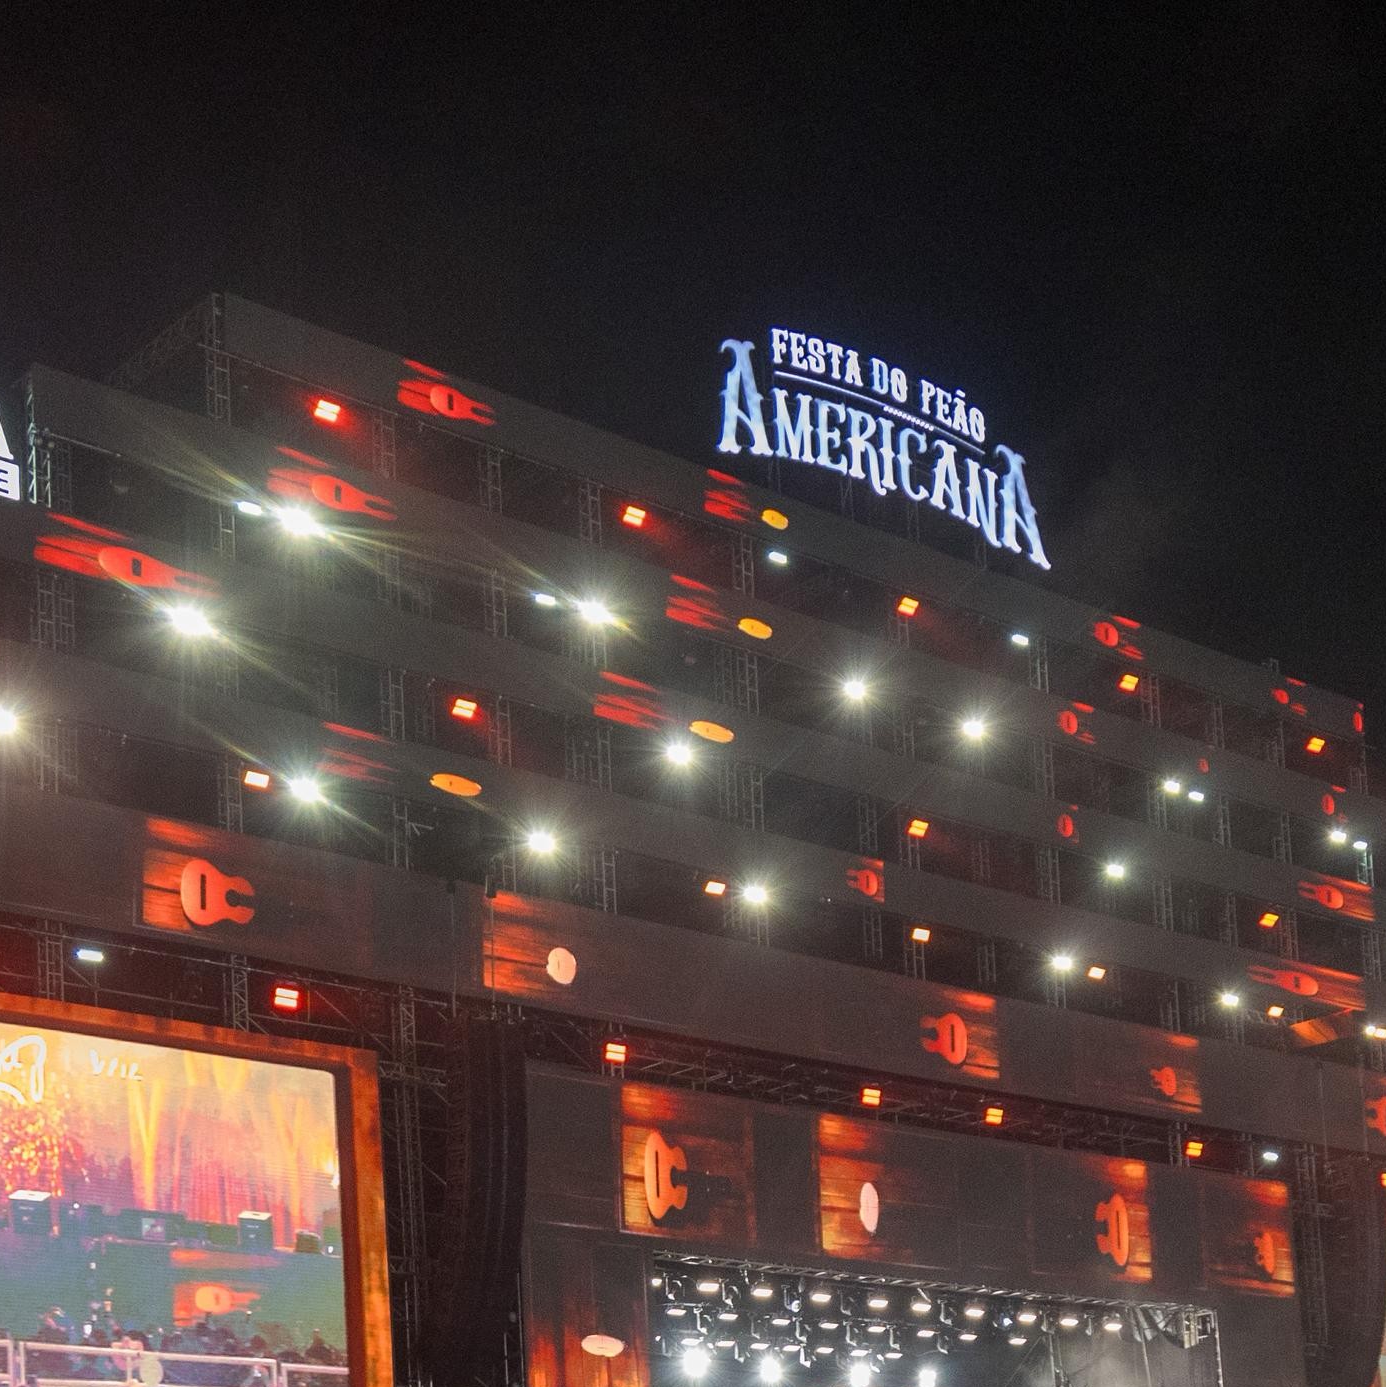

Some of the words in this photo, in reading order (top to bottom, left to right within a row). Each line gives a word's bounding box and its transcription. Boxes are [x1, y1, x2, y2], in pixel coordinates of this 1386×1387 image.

[716, 338, 1052, 571] AMERICANA
[770, 328, 863, 388] FESTA
[870, 356, 908, 403] DO
[920, 378, 986, 444] PEÃO
